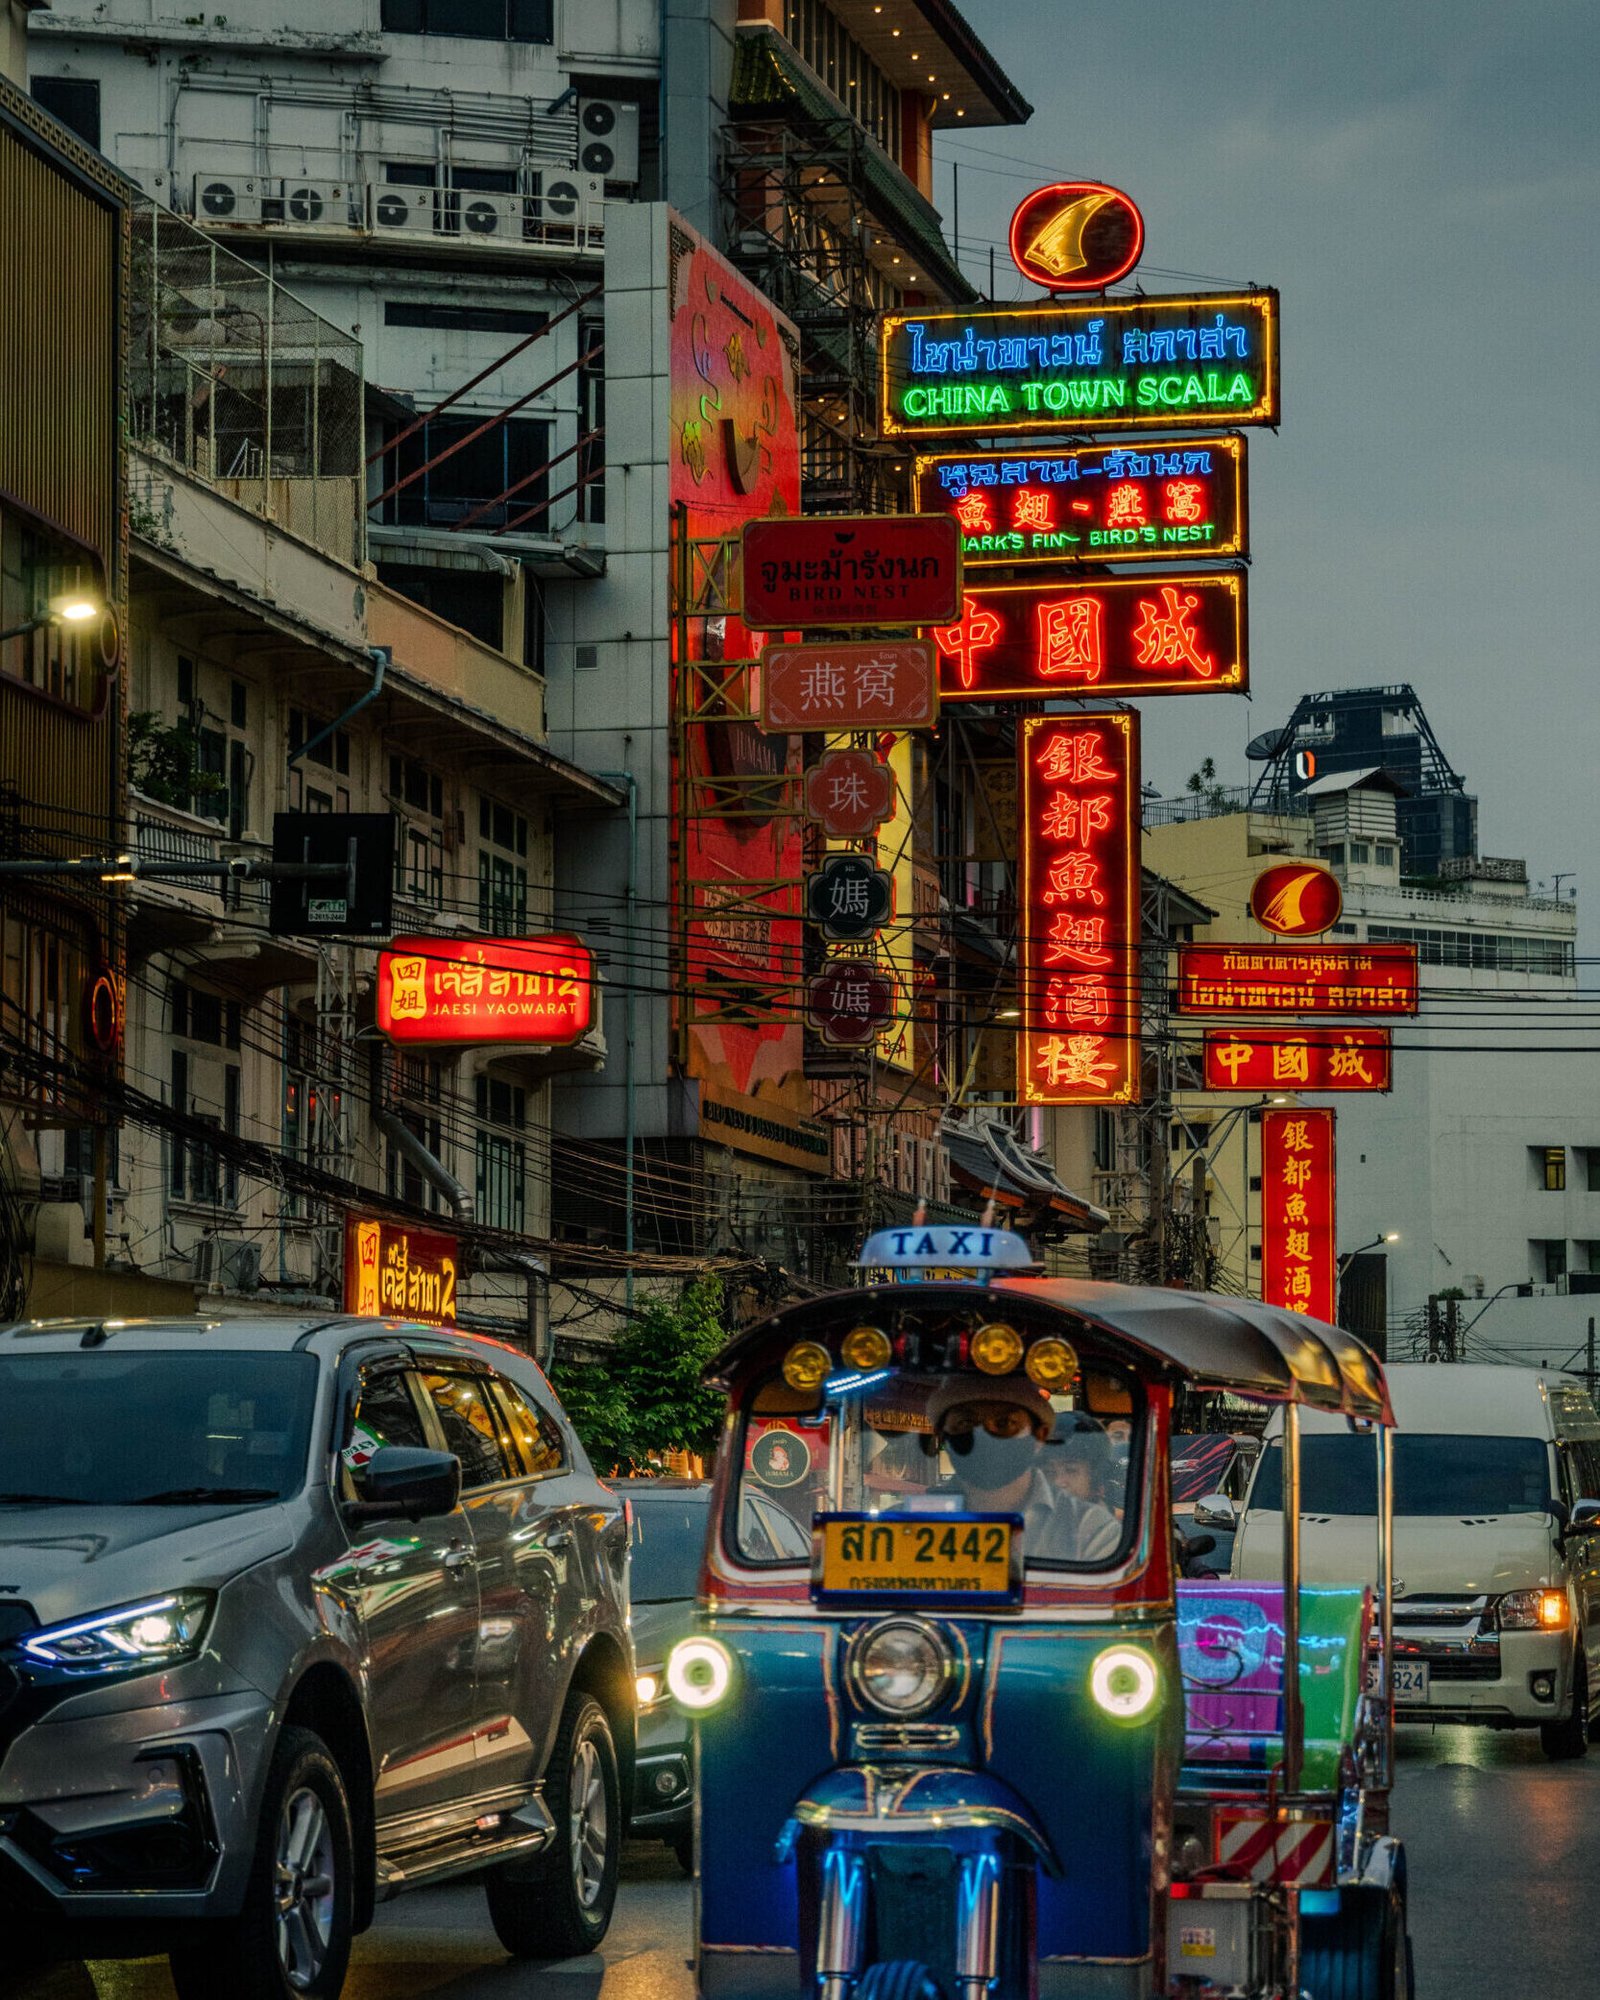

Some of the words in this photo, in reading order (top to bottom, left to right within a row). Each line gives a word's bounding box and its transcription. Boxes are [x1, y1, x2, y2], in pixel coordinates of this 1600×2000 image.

[907, 320, 1104, 373] ไชน่าทาวน์
[1123, 314, 1248, 365] สกาล่า
[904, 385, 1010, 418] CHINA
[1021, 379, 1125, 411] TOWN
[1137, 374, 1253, 407] SCALA
[963, 531, 1024, 552] ARK'S
[1090, 526, 1156, 546] BIRD'S
[1163, 525, 1215, 543] NEST
[789, 586, 842, 602] BIRD
[854, 584, 910, 600] NEST
[933, 587, 1213, 689] 中國城
[828, 771, 870, 814] 珠
[829, 877, 871, 921] 媽
[394, 961, 424, 1012] 四姐
[829, 980, 872, 1023] 媽
[1186, 974, 1317, 1006] ไชน่าทาวน์
[1327, 976, 1408, 1006] สกาล่า
[433, 1003, 477, 1015] JAESI
[486, 1002, 577, 1015] YAOWARAT
[1215, 1034, 1373, 1085] 中國城
[891, 1232, 996, 1257] TAXI
[841, 1526, 895, 1563] สก
[915, 1527, 1005, 1564] 2442
